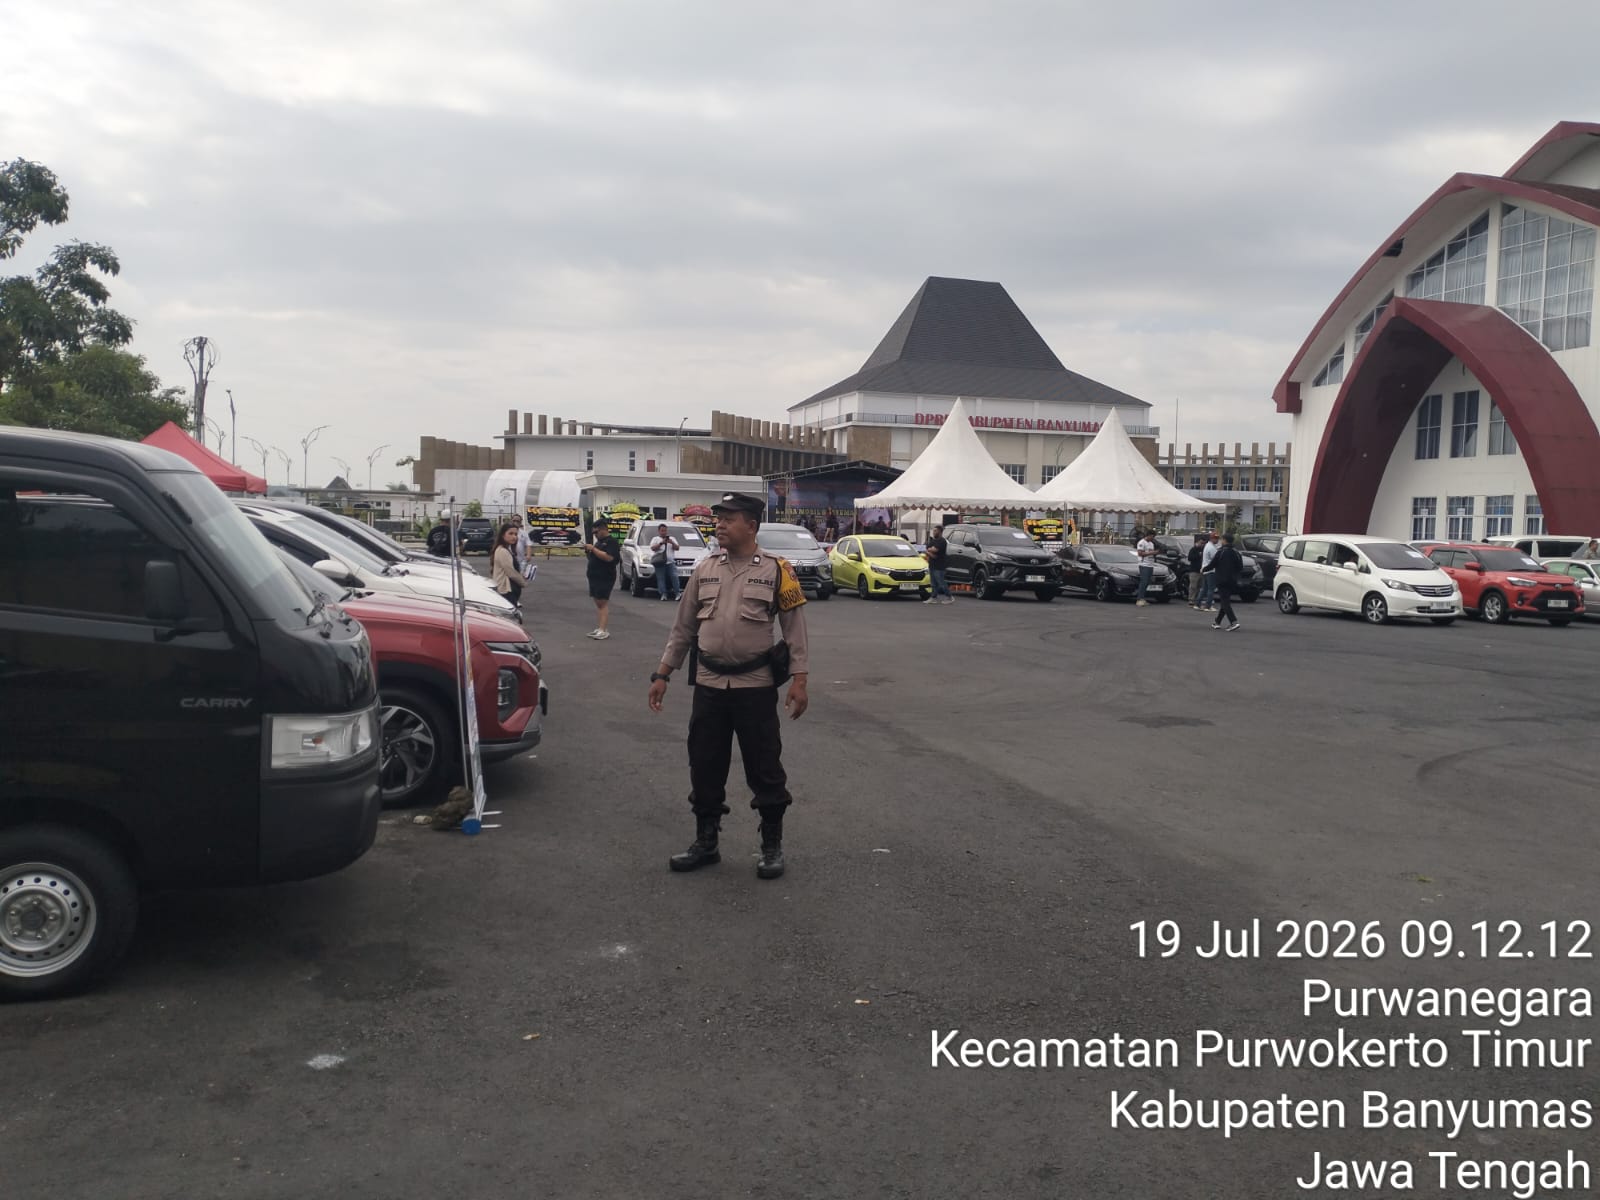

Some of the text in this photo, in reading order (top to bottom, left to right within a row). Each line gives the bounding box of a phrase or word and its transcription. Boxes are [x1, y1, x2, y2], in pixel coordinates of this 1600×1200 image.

[915, 413, 1104, 433] DPR ABUPATEN BANYUMA
[747, 578, 774, 587] POLRI
[180, 697, 253, 708] CARRY
